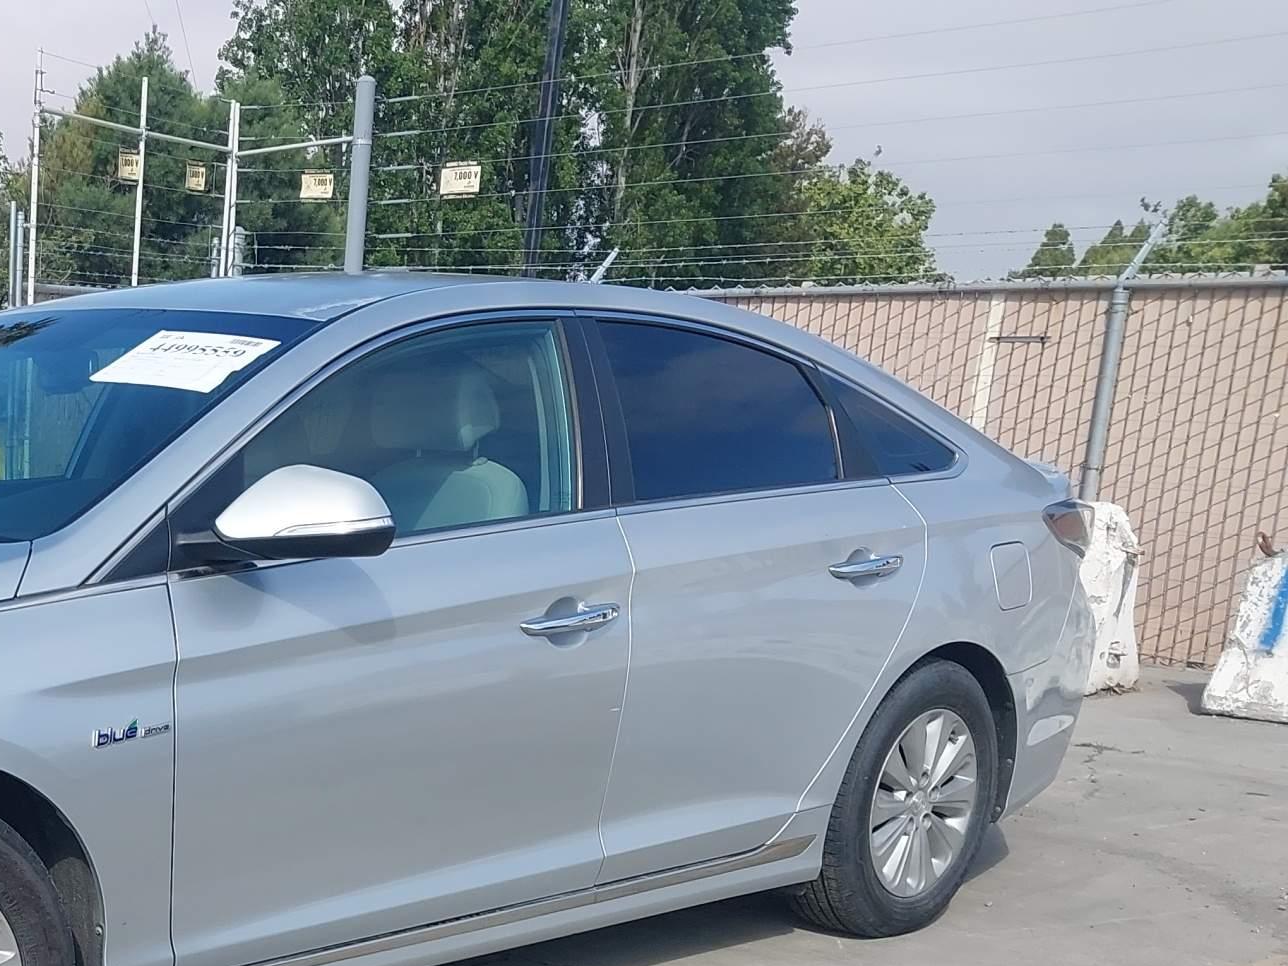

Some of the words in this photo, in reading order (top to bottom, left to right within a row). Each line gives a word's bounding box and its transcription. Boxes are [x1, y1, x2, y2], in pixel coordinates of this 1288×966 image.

[454, 171, 472, 181] 7,000
[474, 171, 479, 179] V
[150, 342, 247, 358] 44995559
[94, 722, 138, 747] blue
